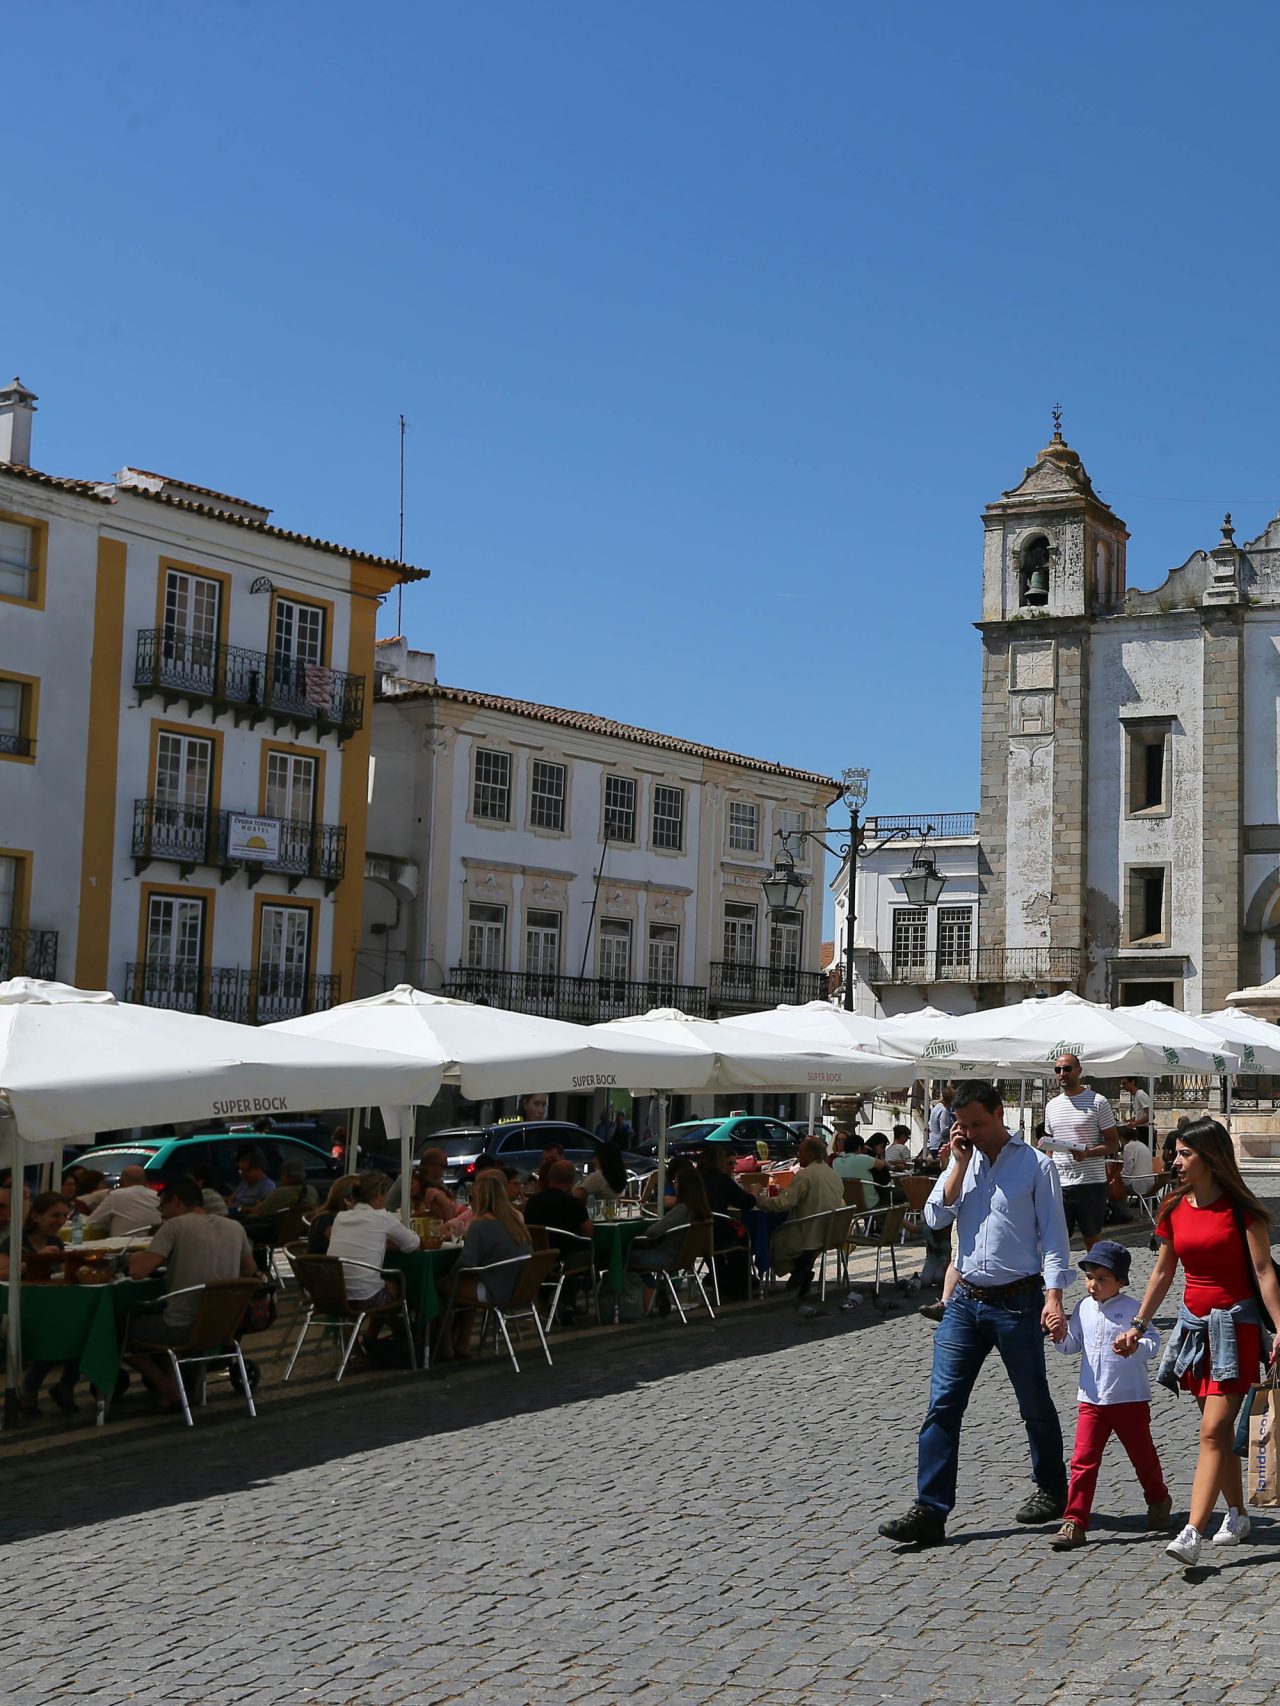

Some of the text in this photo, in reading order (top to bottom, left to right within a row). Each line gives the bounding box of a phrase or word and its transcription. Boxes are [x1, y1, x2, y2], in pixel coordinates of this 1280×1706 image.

[241, 825, 270, 833] HOSTEL
[572, 1074, 616, 1087] SUPER BOCK
[807, 1071, 842, 1082] SUPER BOCK
[213, 1096, 288, 1115] SUPER BOCK
